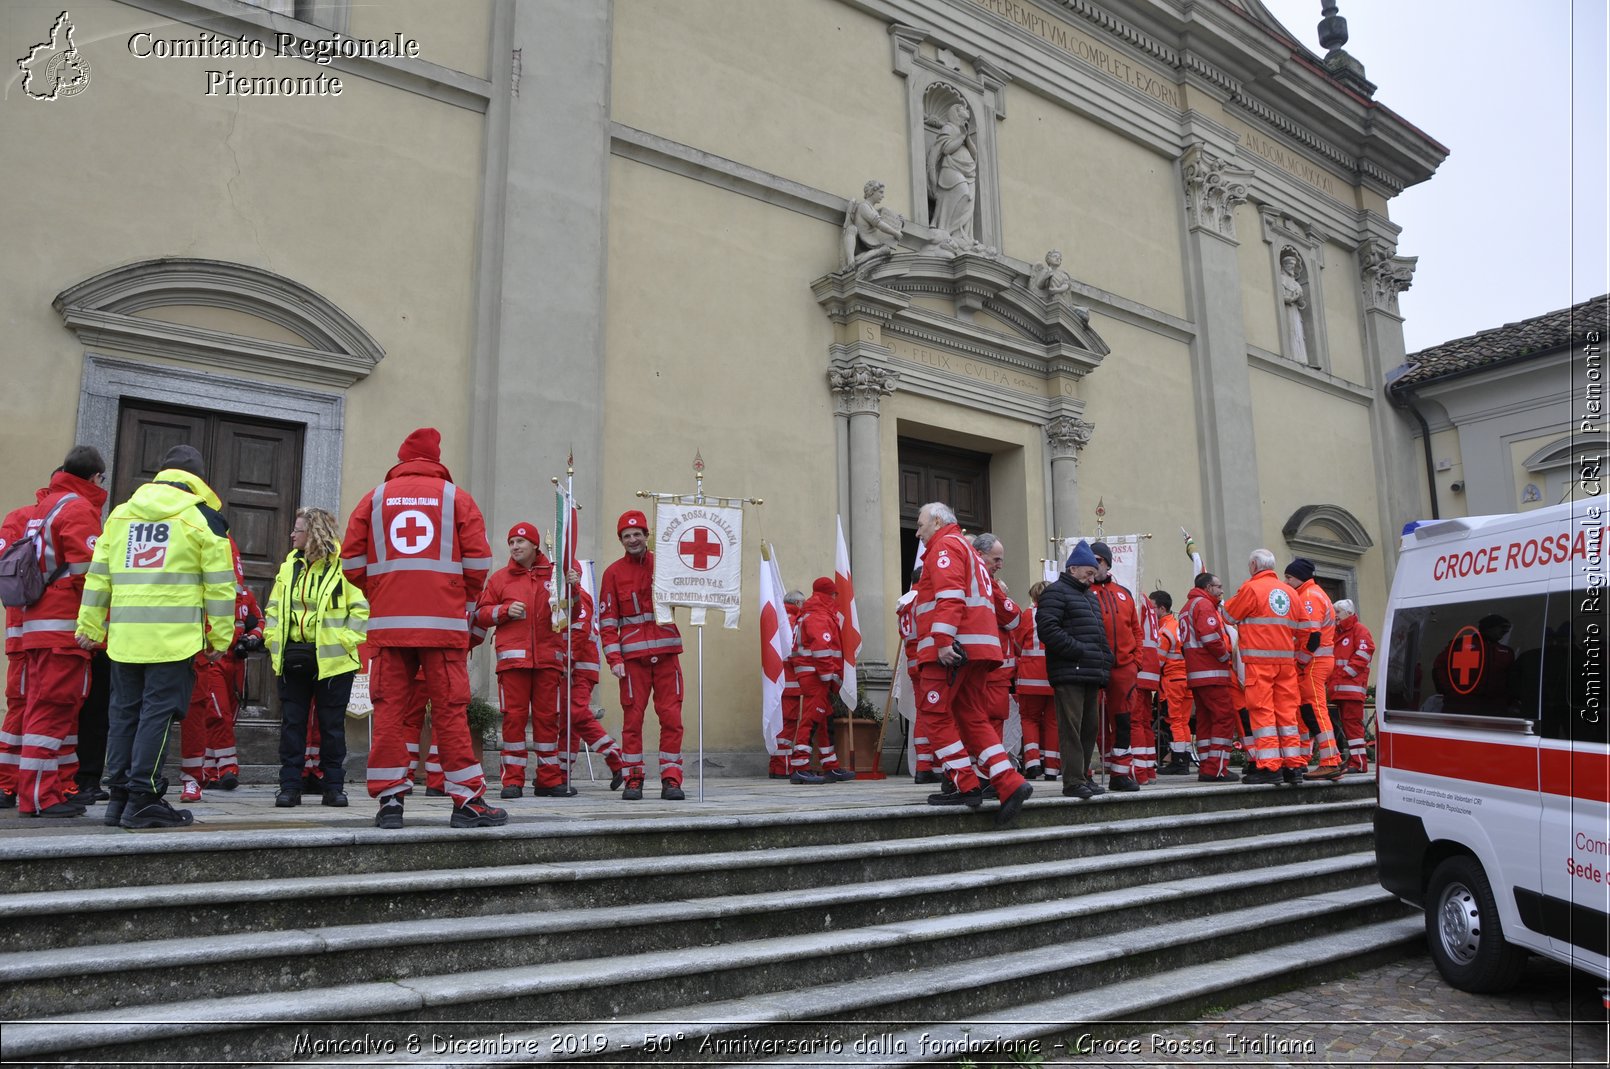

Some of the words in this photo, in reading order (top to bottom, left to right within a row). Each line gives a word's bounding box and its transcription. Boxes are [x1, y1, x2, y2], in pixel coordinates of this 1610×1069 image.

[912, 346, 950, 369] FELIX
[964, 361, 1010, 386] CVLPA
[134, 523, 170, 543] 118
[661, 516, 682, 543] CROCE
[681, 509, 707, 522] ROSSA
[709, 512, 737, 547] ITALIANA
[125, 523, 136, 568] PIEMONTE
[1433, 545, 1502, 581] CROCE
[1505, 530, 1587, 571] ROSSA
[673, 576, 705, 587] GRUPPO
[655, 591, 668, 602] VAL
[670, 592, 703, 602] BORMIDA
[704, 592, 740, 606] ASTIGIANA
[1566, 857, 1601, 884] Sede
